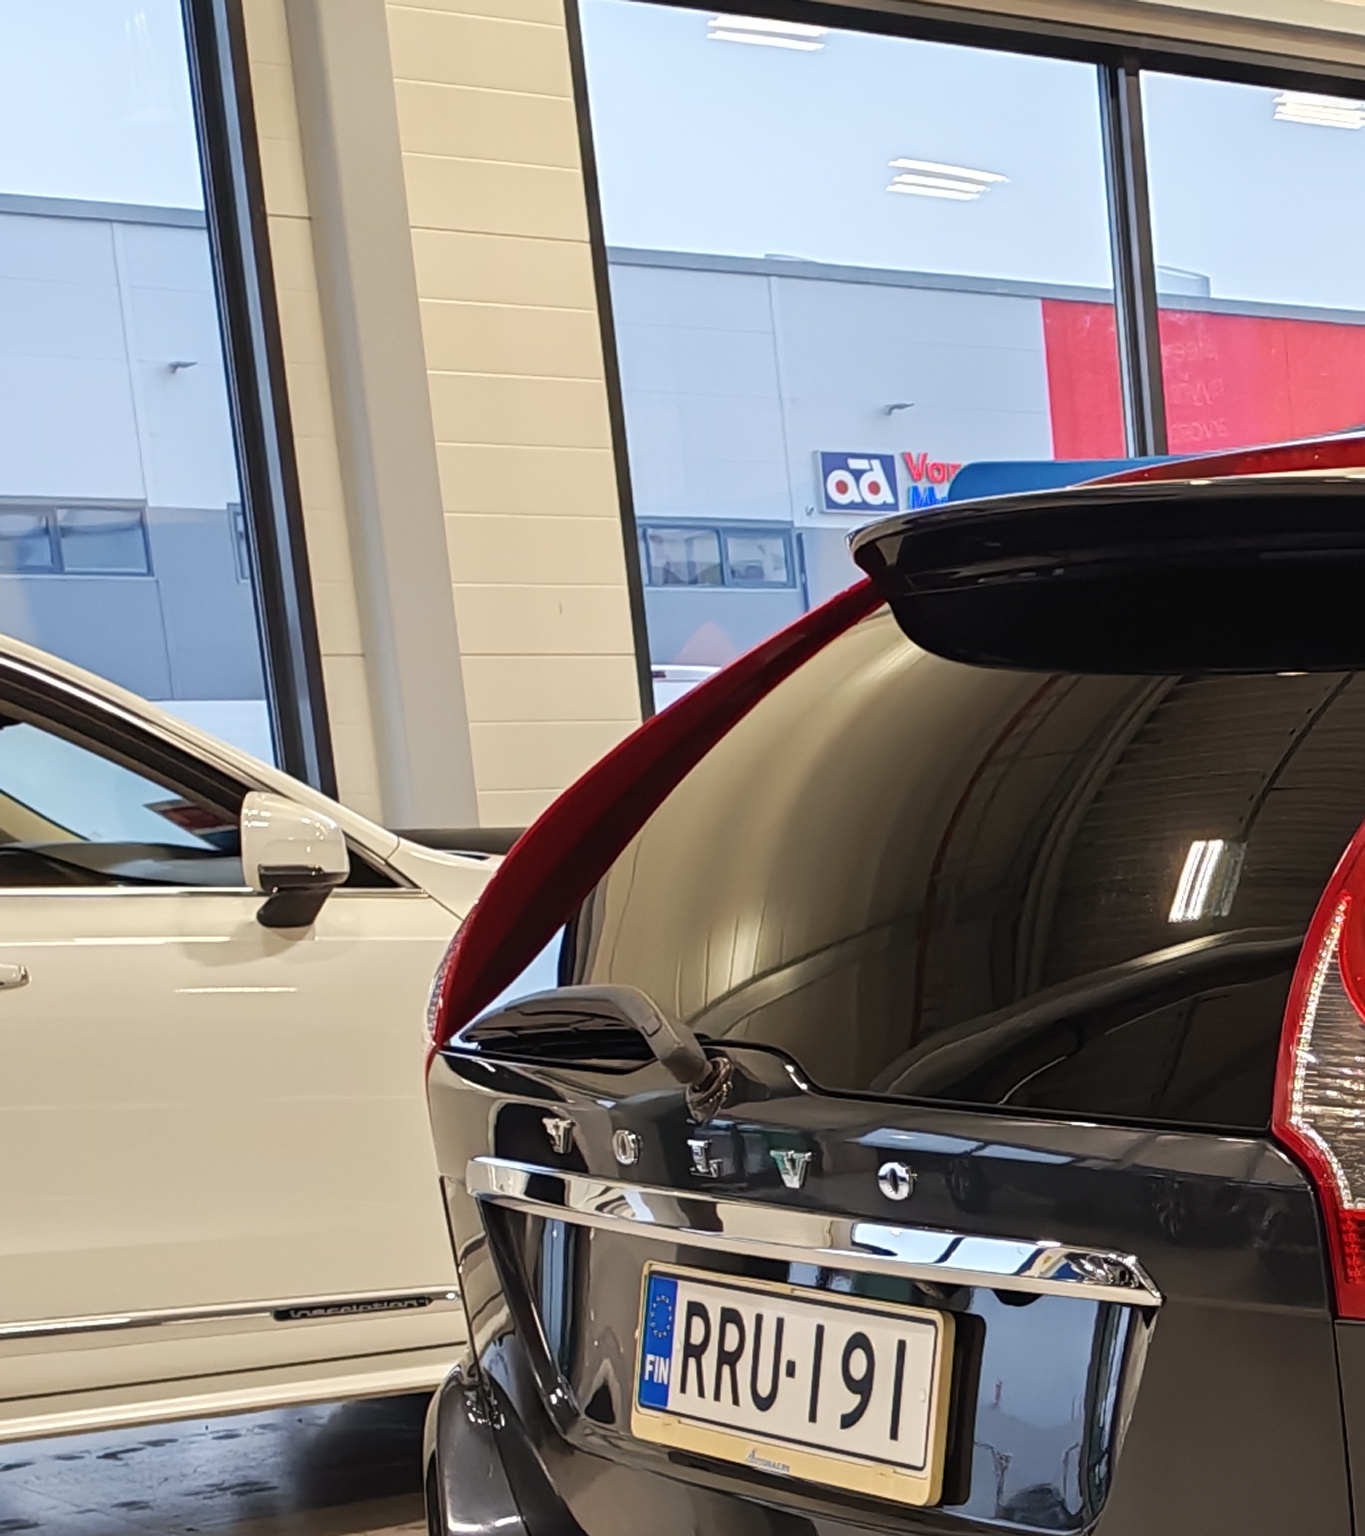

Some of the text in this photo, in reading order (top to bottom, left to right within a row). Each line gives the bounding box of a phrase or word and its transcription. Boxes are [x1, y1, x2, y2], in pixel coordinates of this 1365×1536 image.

[541, 1117, 914, 1201] VOLVO
[644, 1353, 670, 1386] FIN
[679, 1300, 907, 1441] RRU-191
